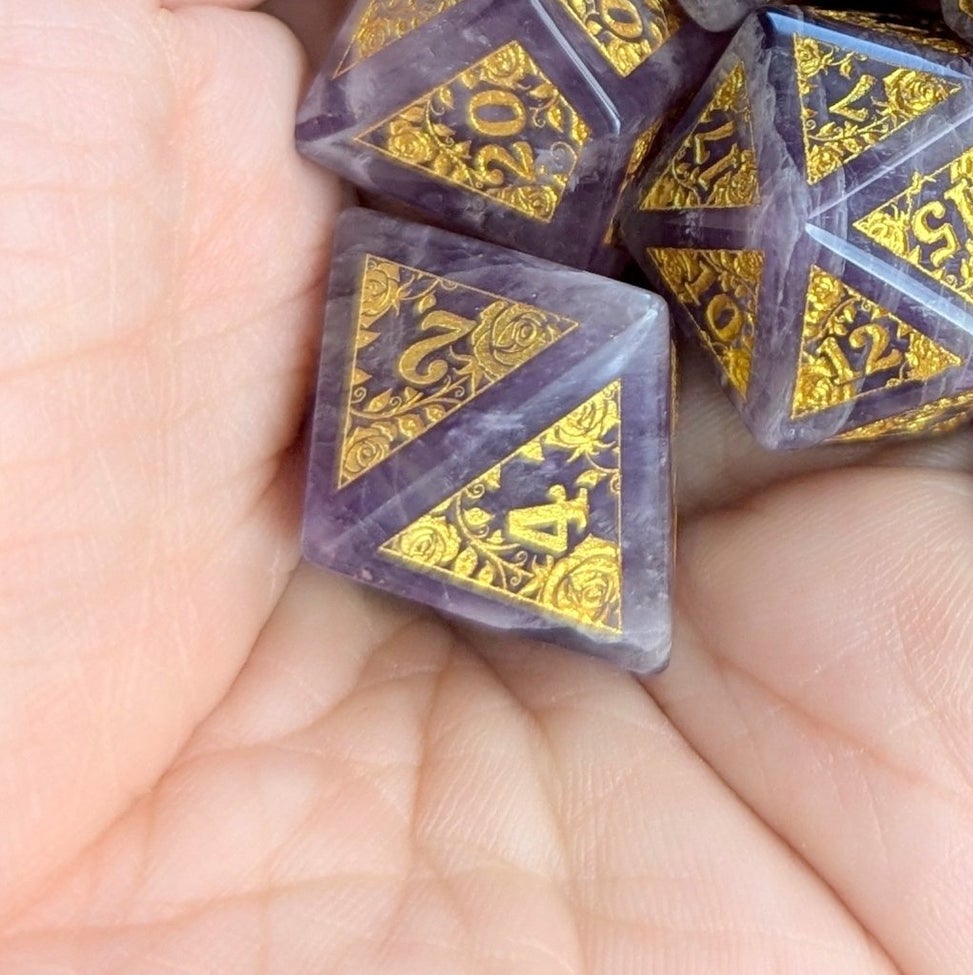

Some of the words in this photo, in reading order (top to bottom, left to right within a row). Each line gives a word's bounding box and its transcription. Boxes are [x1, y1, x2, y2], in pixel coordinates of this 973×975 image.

[829, 75, 877, 121] 7
[468, 89, 536, 184] 20
[694, 120, 739, 192] 17
[684, 260, 744, 343] 10
[399, 309, 478, 385] 2
[819, 324, 902, 385] 12
[509, 484, 589, 553] 4
